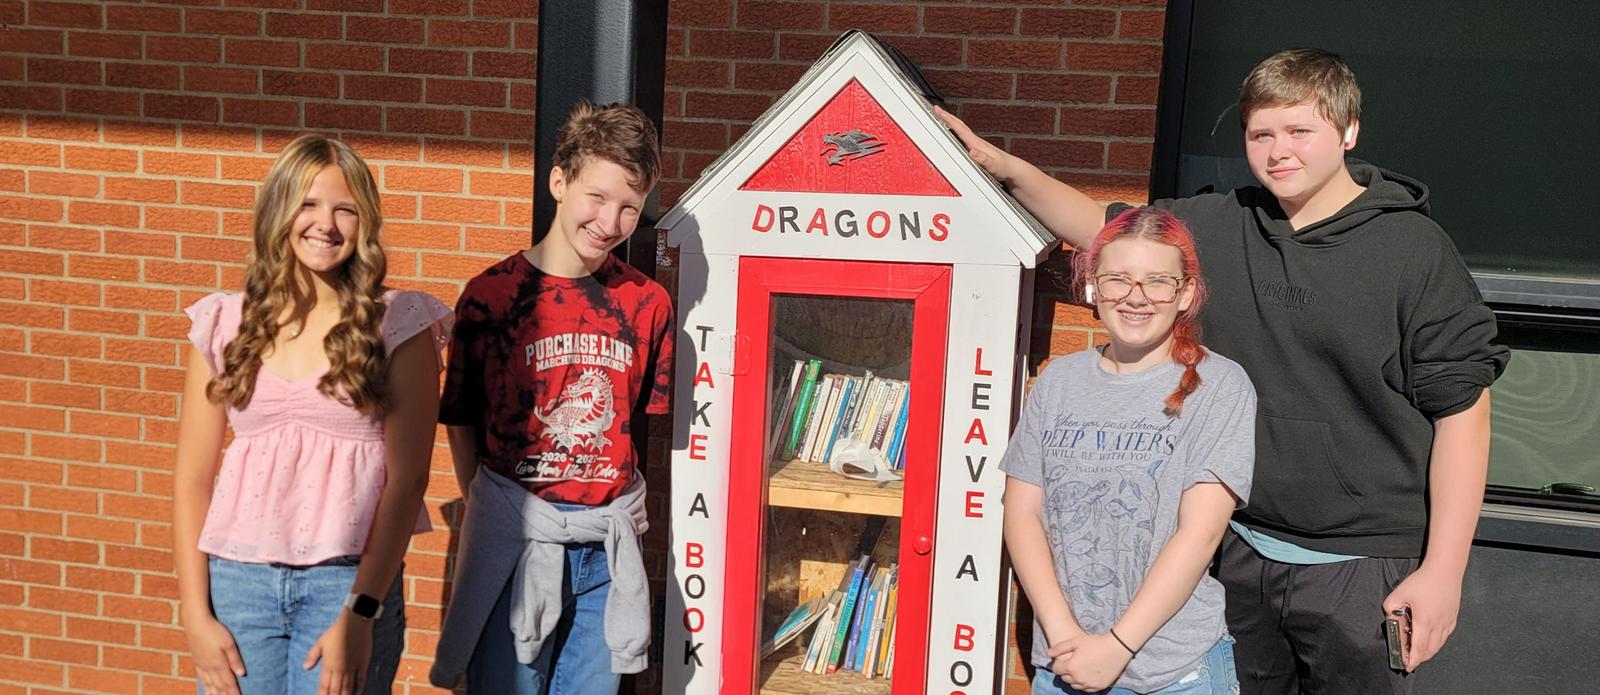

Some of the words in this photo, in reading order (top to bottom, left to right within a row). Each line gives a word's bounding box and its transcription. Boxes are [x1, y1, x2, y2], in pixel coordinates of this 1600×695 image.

[752, 204, 951, 242] DRAGONS
[1257, 280, 1320, 304] ORIGINALS
[525, 333, 598, 366] PURCHASE
[601, 335, 633, 367] LINE
[535, 354, 580, 372] MARCHING
[581, 355, 625, 373] DRAGONS
[689, 325, 715, 460] TAKE
[964, 347, 993, 518] LEAVE
[1054, 412, 1079, 428] When
[1081, 421, 1100, 432] you
[1099, 421, 1128, 432] pass
[1129, 416, 1176, 434] through
[1040, 429, 1085, 448] DEEP
[1096, 431, 1177, 455] WATERS
[541, 452, 567, 462] 2026
[1052, 449, 1076, 459] WILL
[1081, 451, 1093, 460] BE
[1099, 451, 1124, 461] WITH
[1129, 451, 1152, 462] YOU
[536, 461, 561, 478] Your
[593, 463, 620, 479] Color
[688, 492, 710, 518] A
[955, 554, 980, 582] A
[683, 542, 705, 667] BOOK
[948, 623, 976, 695] BO
